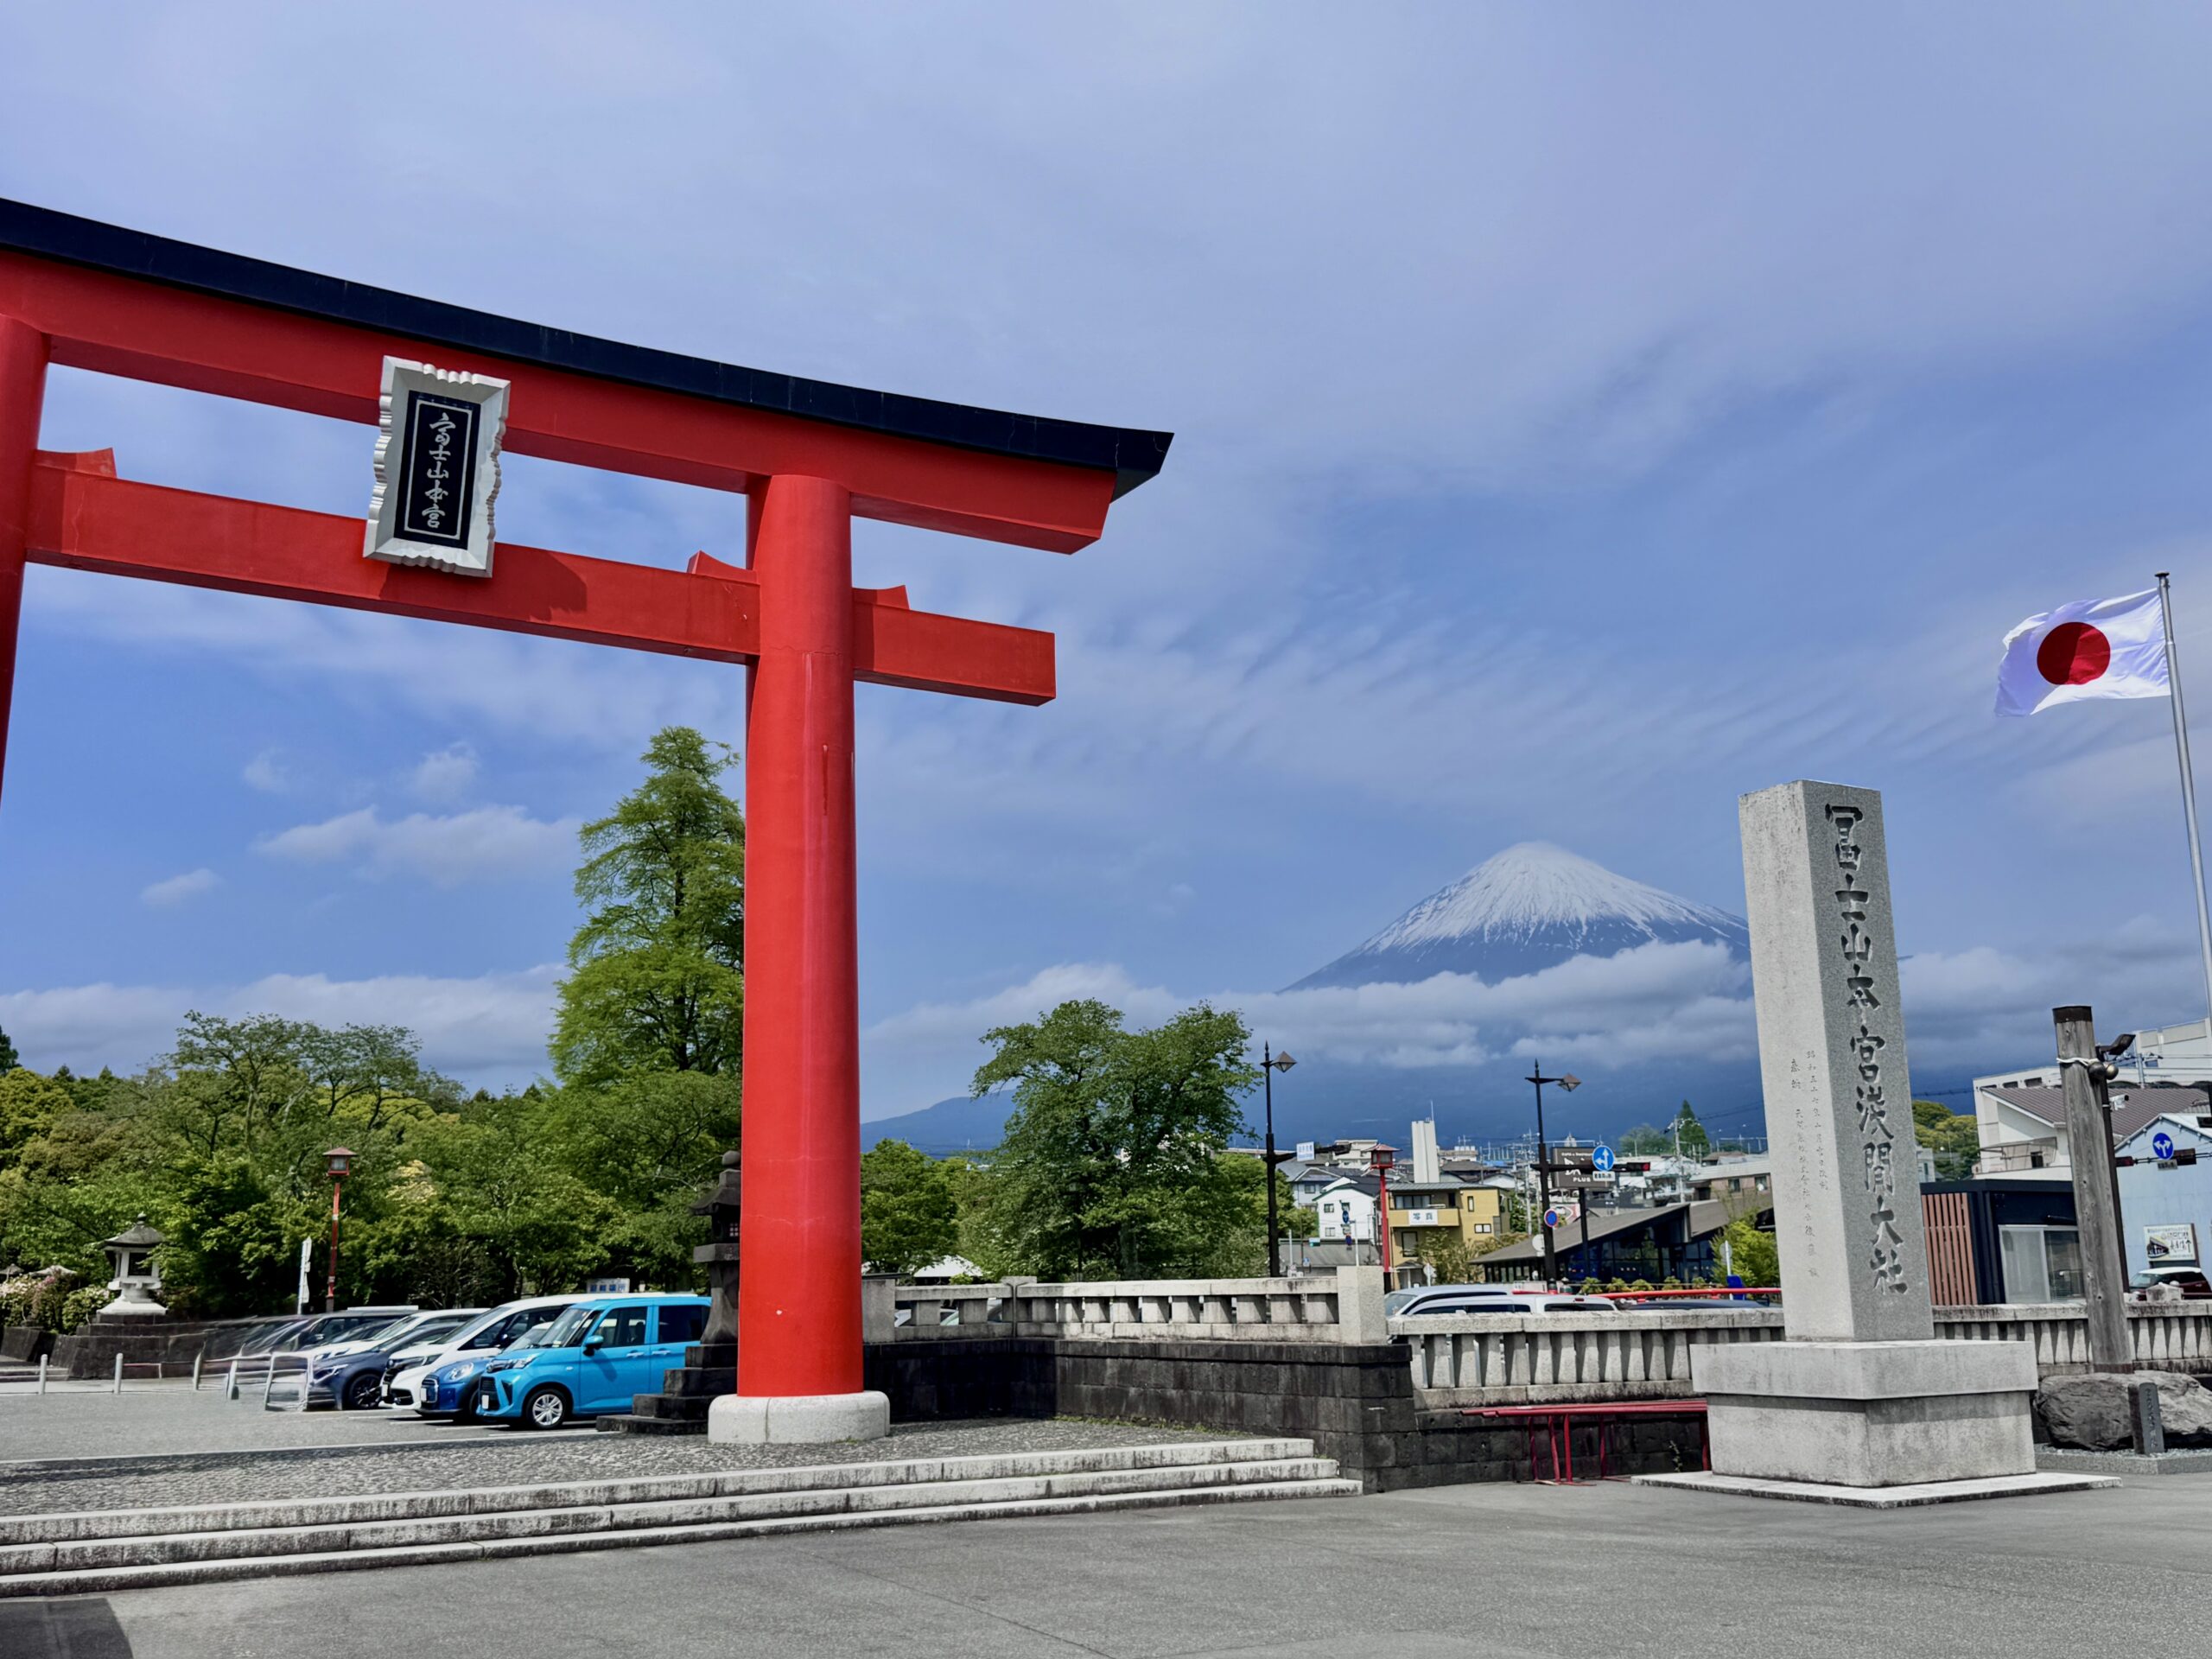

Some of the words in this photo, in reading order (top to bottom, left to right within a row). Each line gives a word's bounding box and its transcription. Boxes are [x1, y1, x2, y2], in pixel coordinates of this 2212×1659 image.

[421, 411, 456, 529] 富士山本宮
